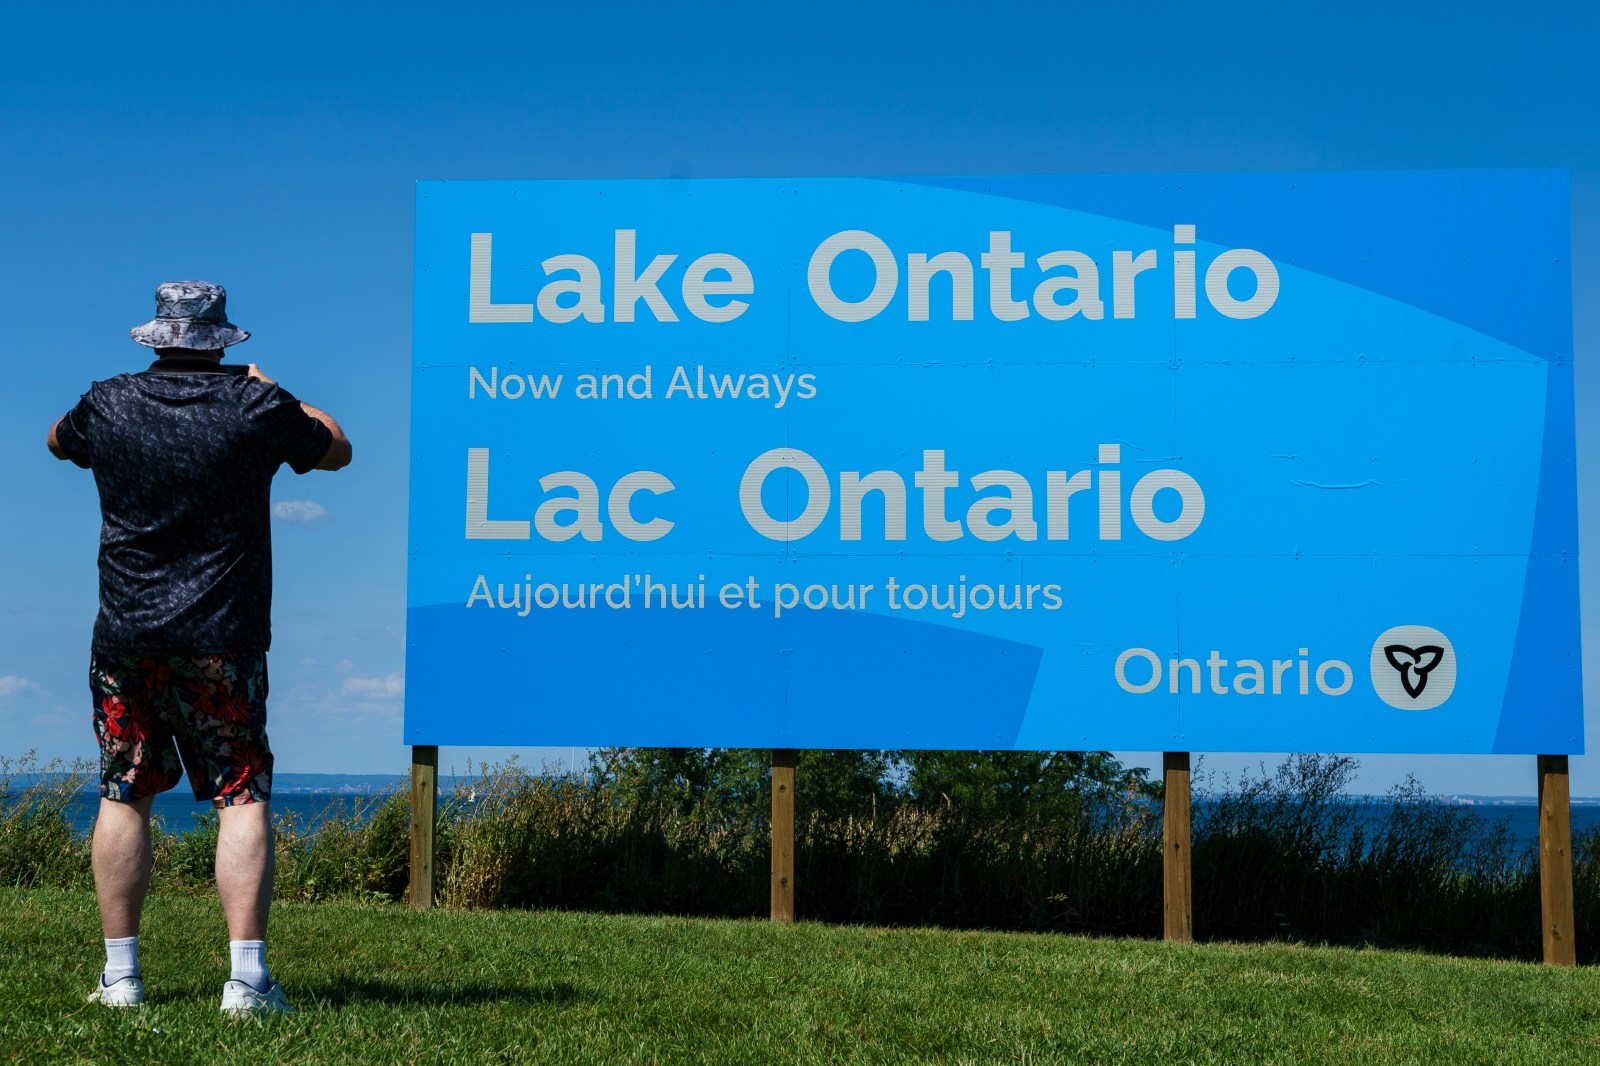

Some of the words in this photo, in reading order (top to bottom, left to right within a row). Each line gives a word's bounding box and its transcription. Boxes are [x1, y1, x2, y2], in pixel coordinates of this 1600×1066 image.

[469, 229, 755, 323] Lake
[808, 225, 1280, 322] Ontario
[469, 367, 563, 400] Now
[576, 365, 653, 400] and
[666, 365, 817, 409] Always
[466, 447, 676, 541] Lac
[740, 444, 1206, 541] Ontario
[467, 575, 705, 617] Aujourd’hui
[720, 576, 761, 609] et
[775, 583, 874, 619] pour
[886, 576, 1063, 619] toujours
[1114, 647, 1354, 696] Ontario
